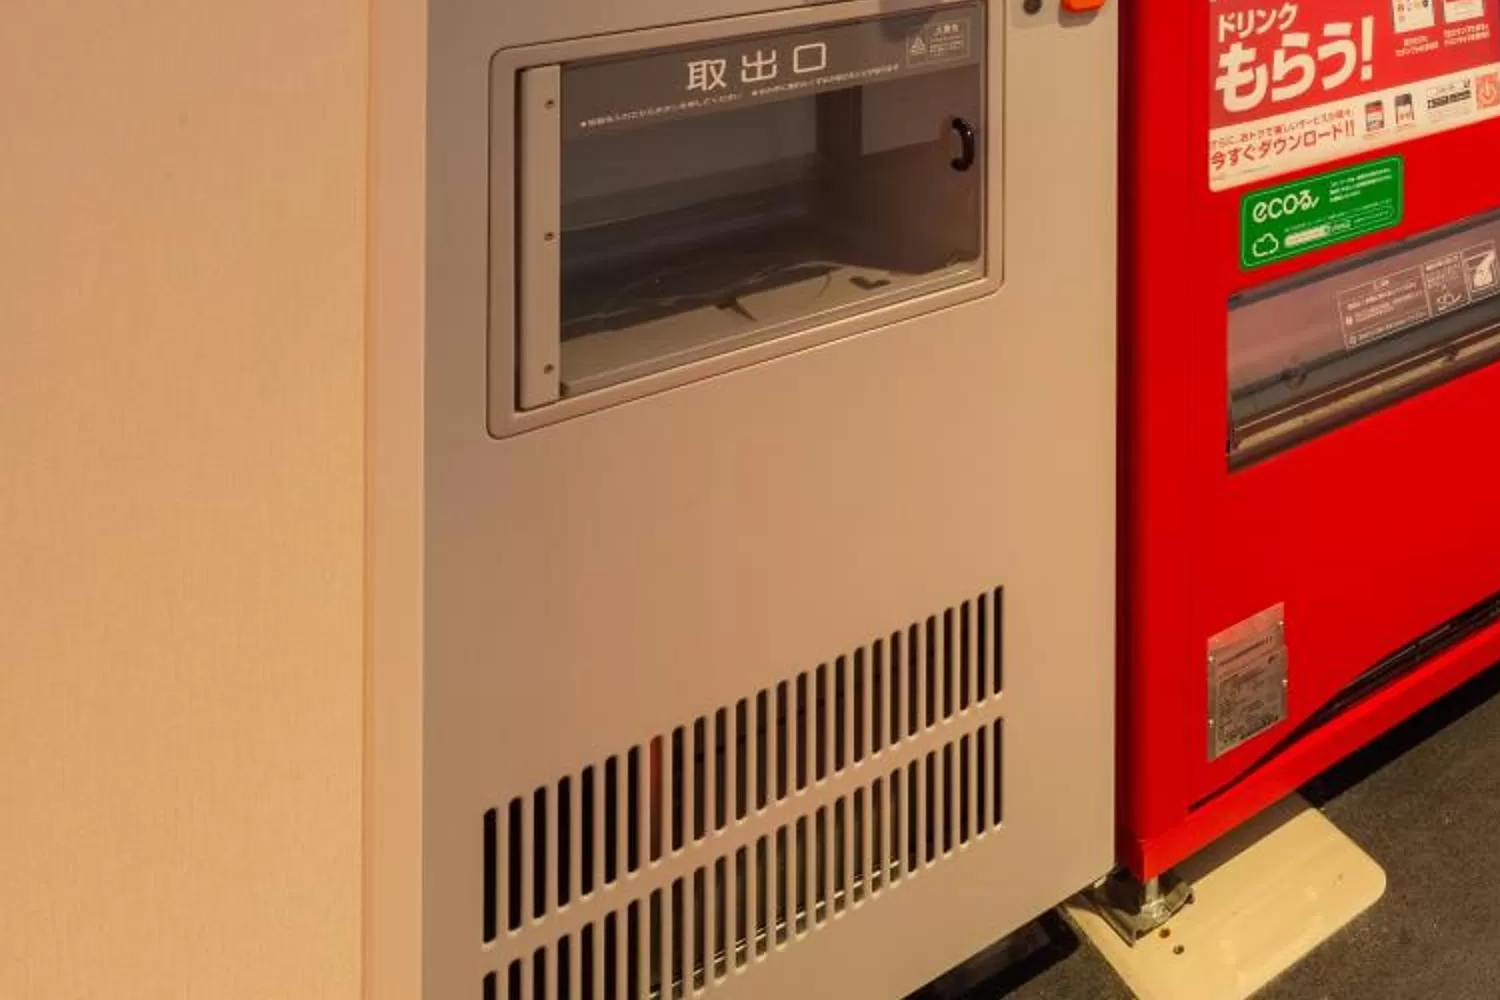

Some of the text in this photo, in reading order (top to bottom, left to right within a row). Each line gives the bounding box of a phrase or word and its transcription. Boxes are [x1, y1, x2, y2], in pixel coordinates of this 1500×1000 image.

[1217, 2, 1298, 42] ドリンク
[686, 41, 828, 92] 取出口
[1215, 15, 1375, 113] もらう!
